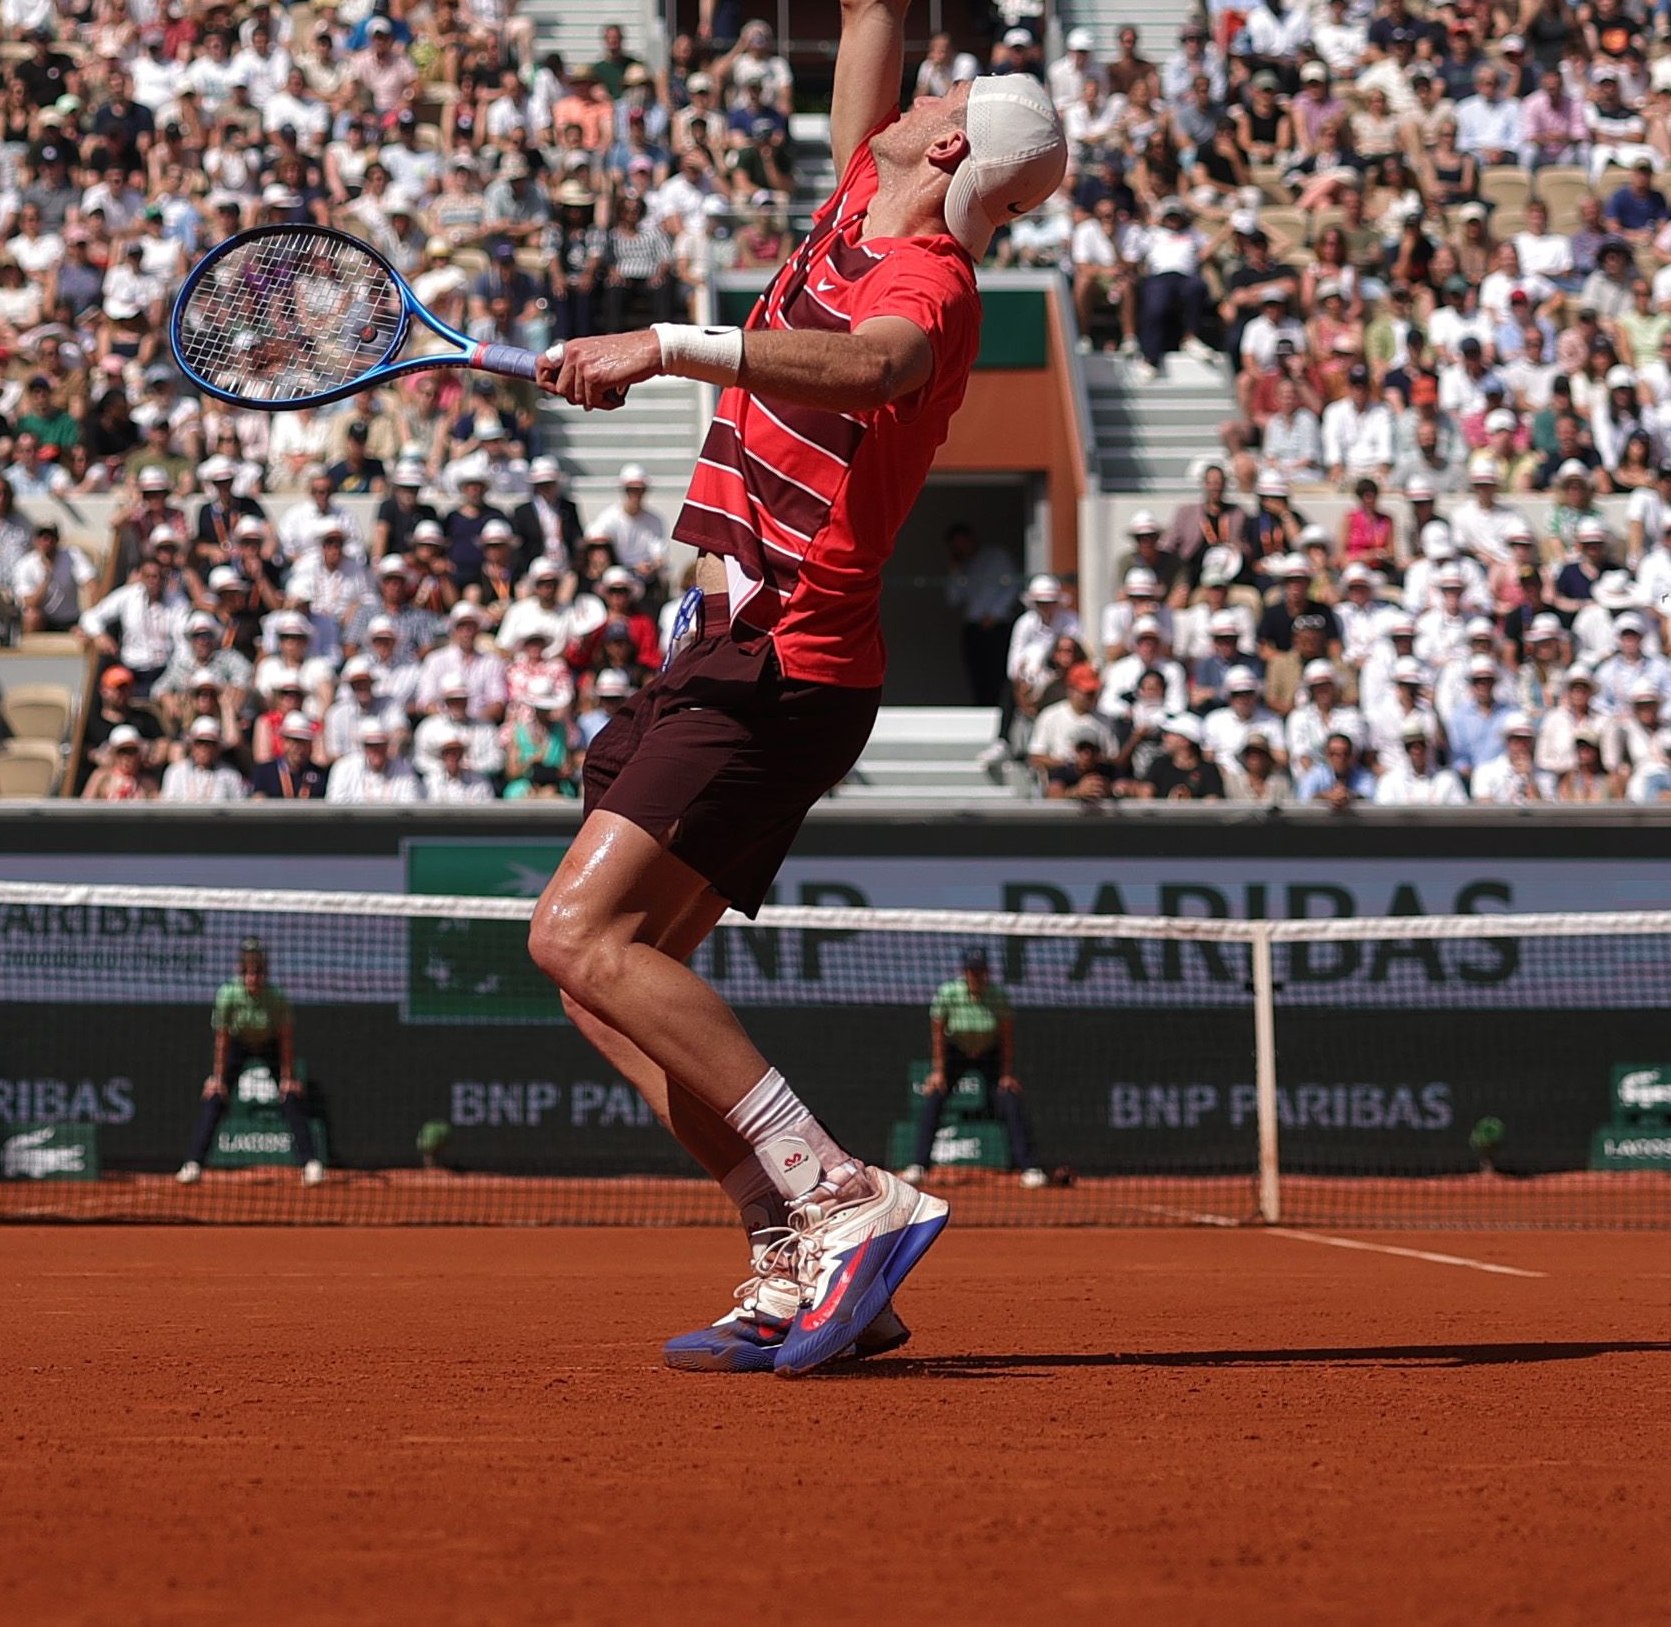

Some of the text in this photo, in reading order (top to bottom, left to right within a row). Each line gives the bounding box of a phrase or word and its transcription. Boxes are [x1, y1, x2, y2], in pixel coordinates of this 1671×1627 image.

[711, 880, 1520, 983] NP PARIBAS
[451, 1080, 560, 1126] BNP
[1108, 1081, 1220, 1129] BNP
